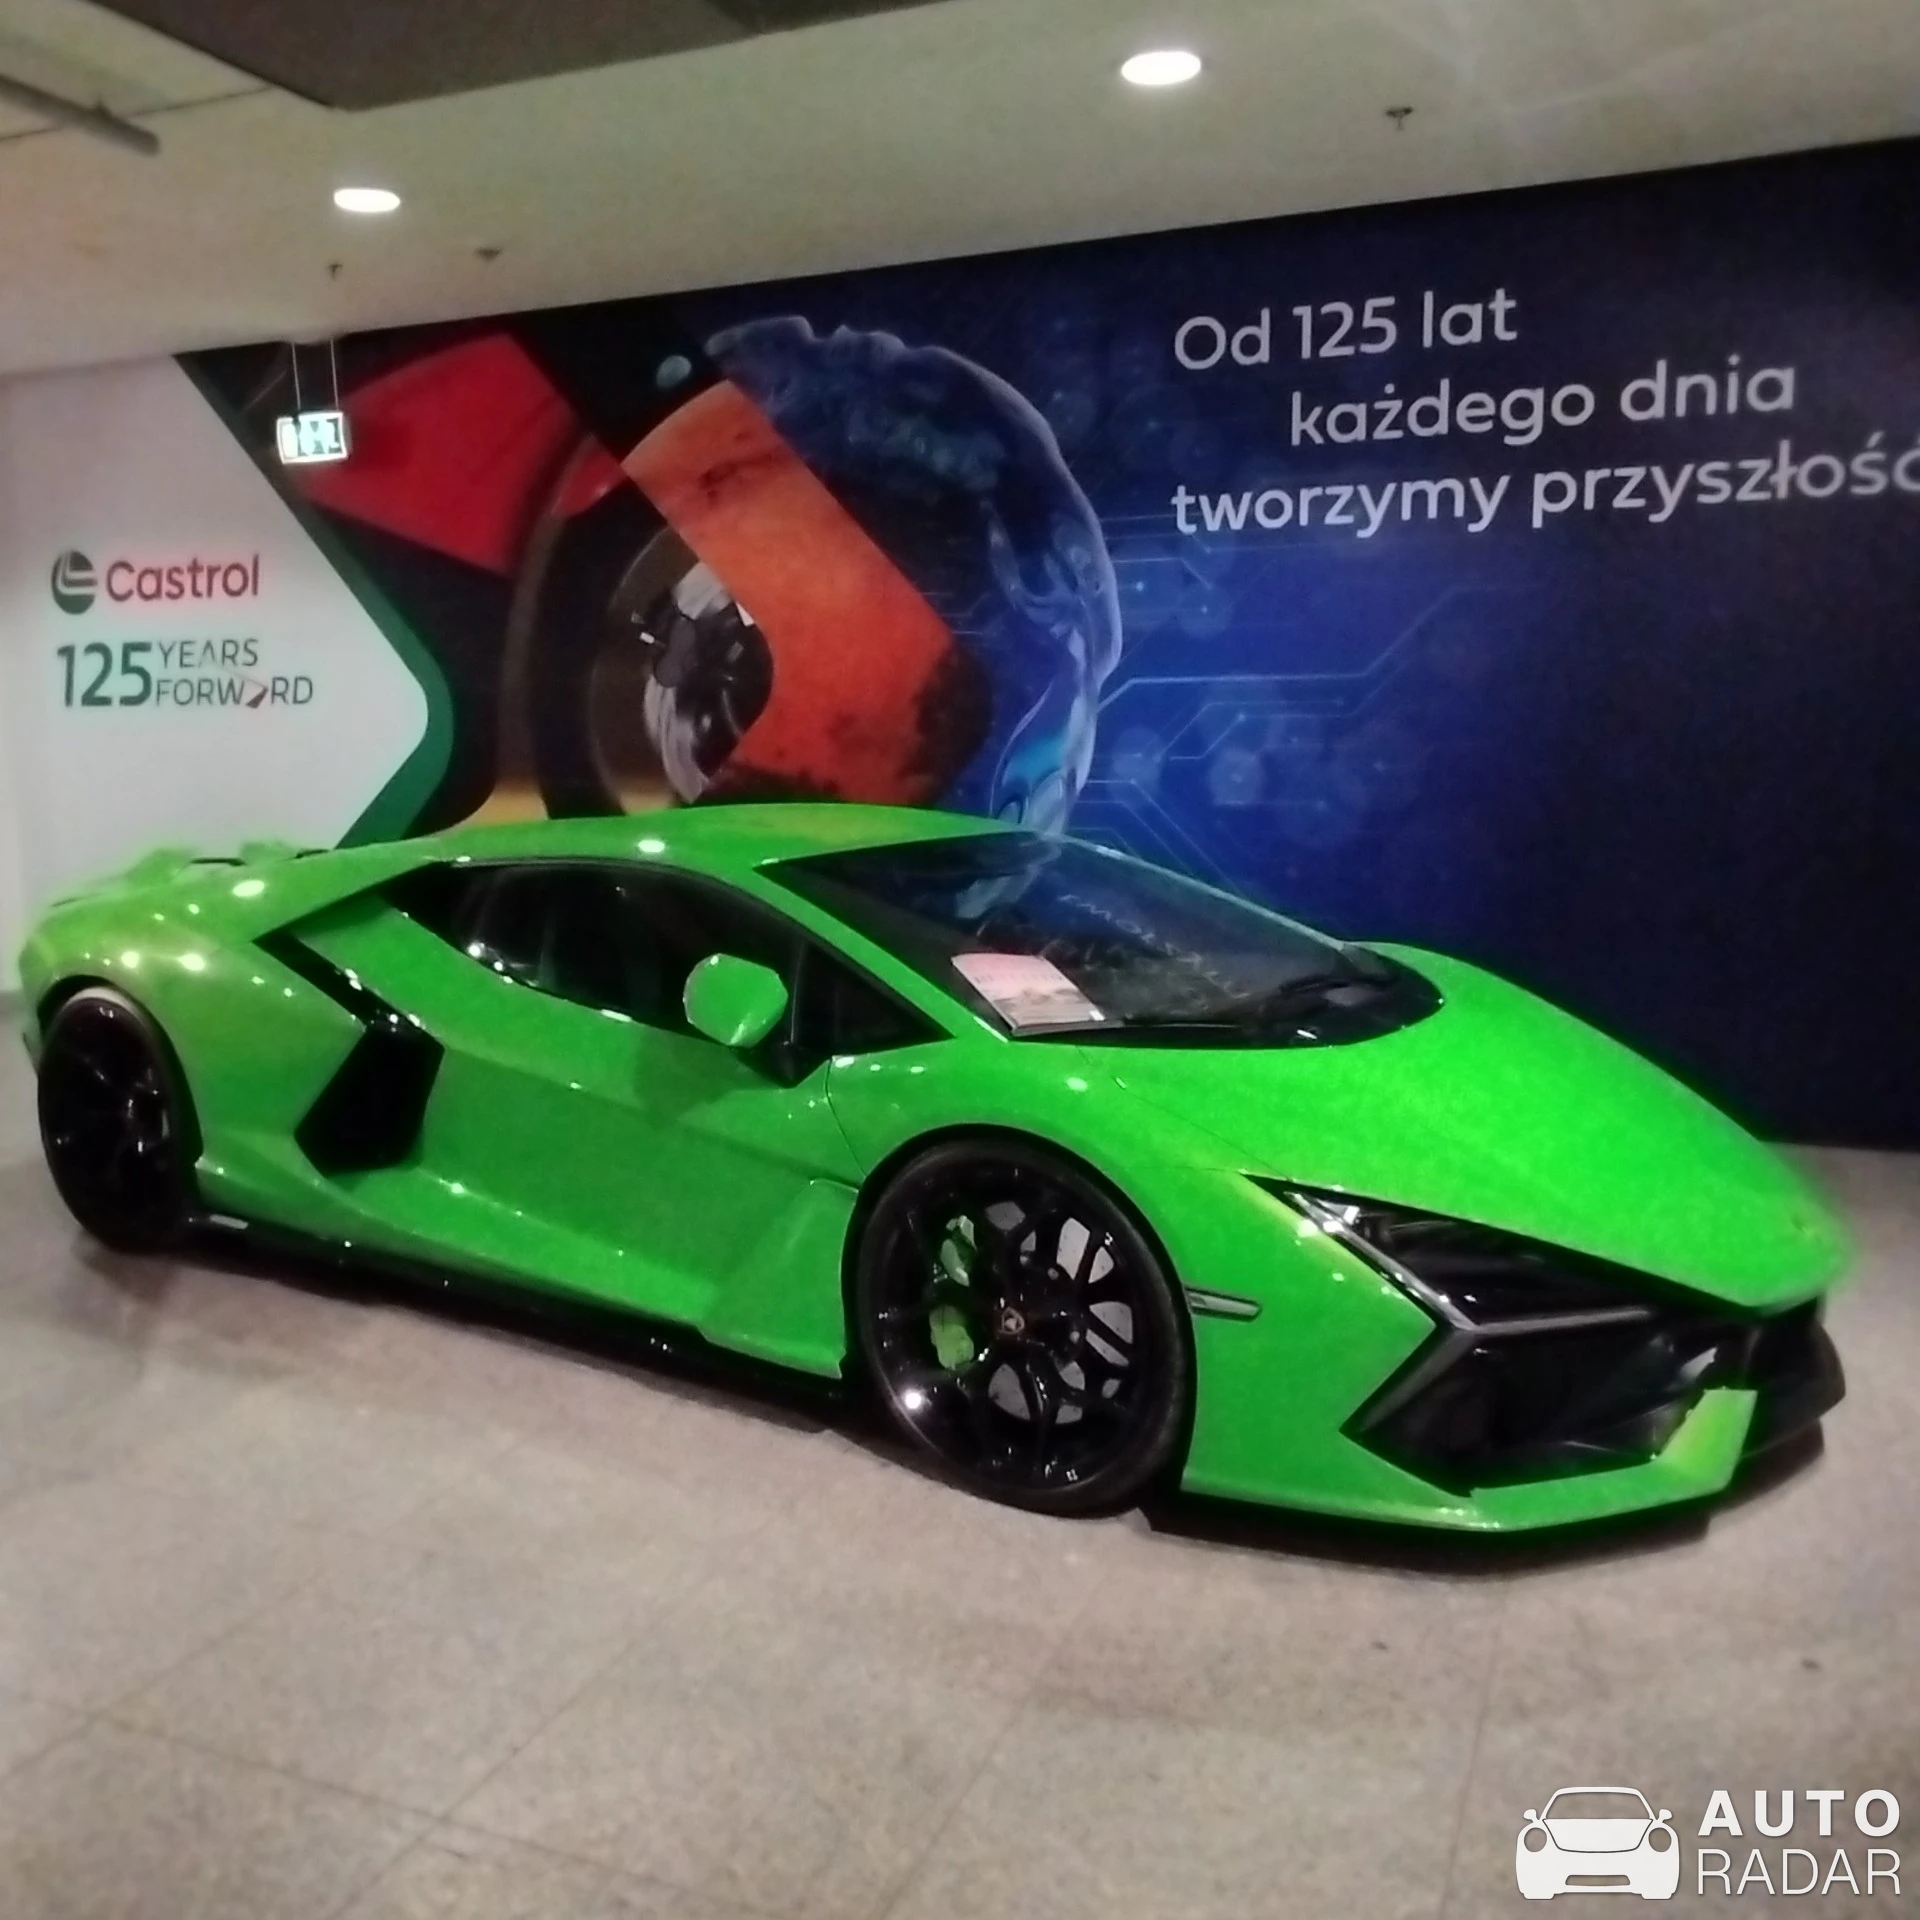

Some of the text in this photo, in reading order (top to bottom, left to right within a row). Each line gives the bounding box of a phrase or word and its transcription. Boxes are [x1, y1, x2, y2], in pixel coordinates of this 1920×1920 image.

[1174, 288, 1518, 371] Od 125 lat
[1290, 354, 1797, 446] każdego dnia
[1171, 473, 1511, 538] tworzymy
[105, 552, 261, 602] Castrol
[56, 641, 152, 708] 125
[157, 638, 260, 669] YEARS
